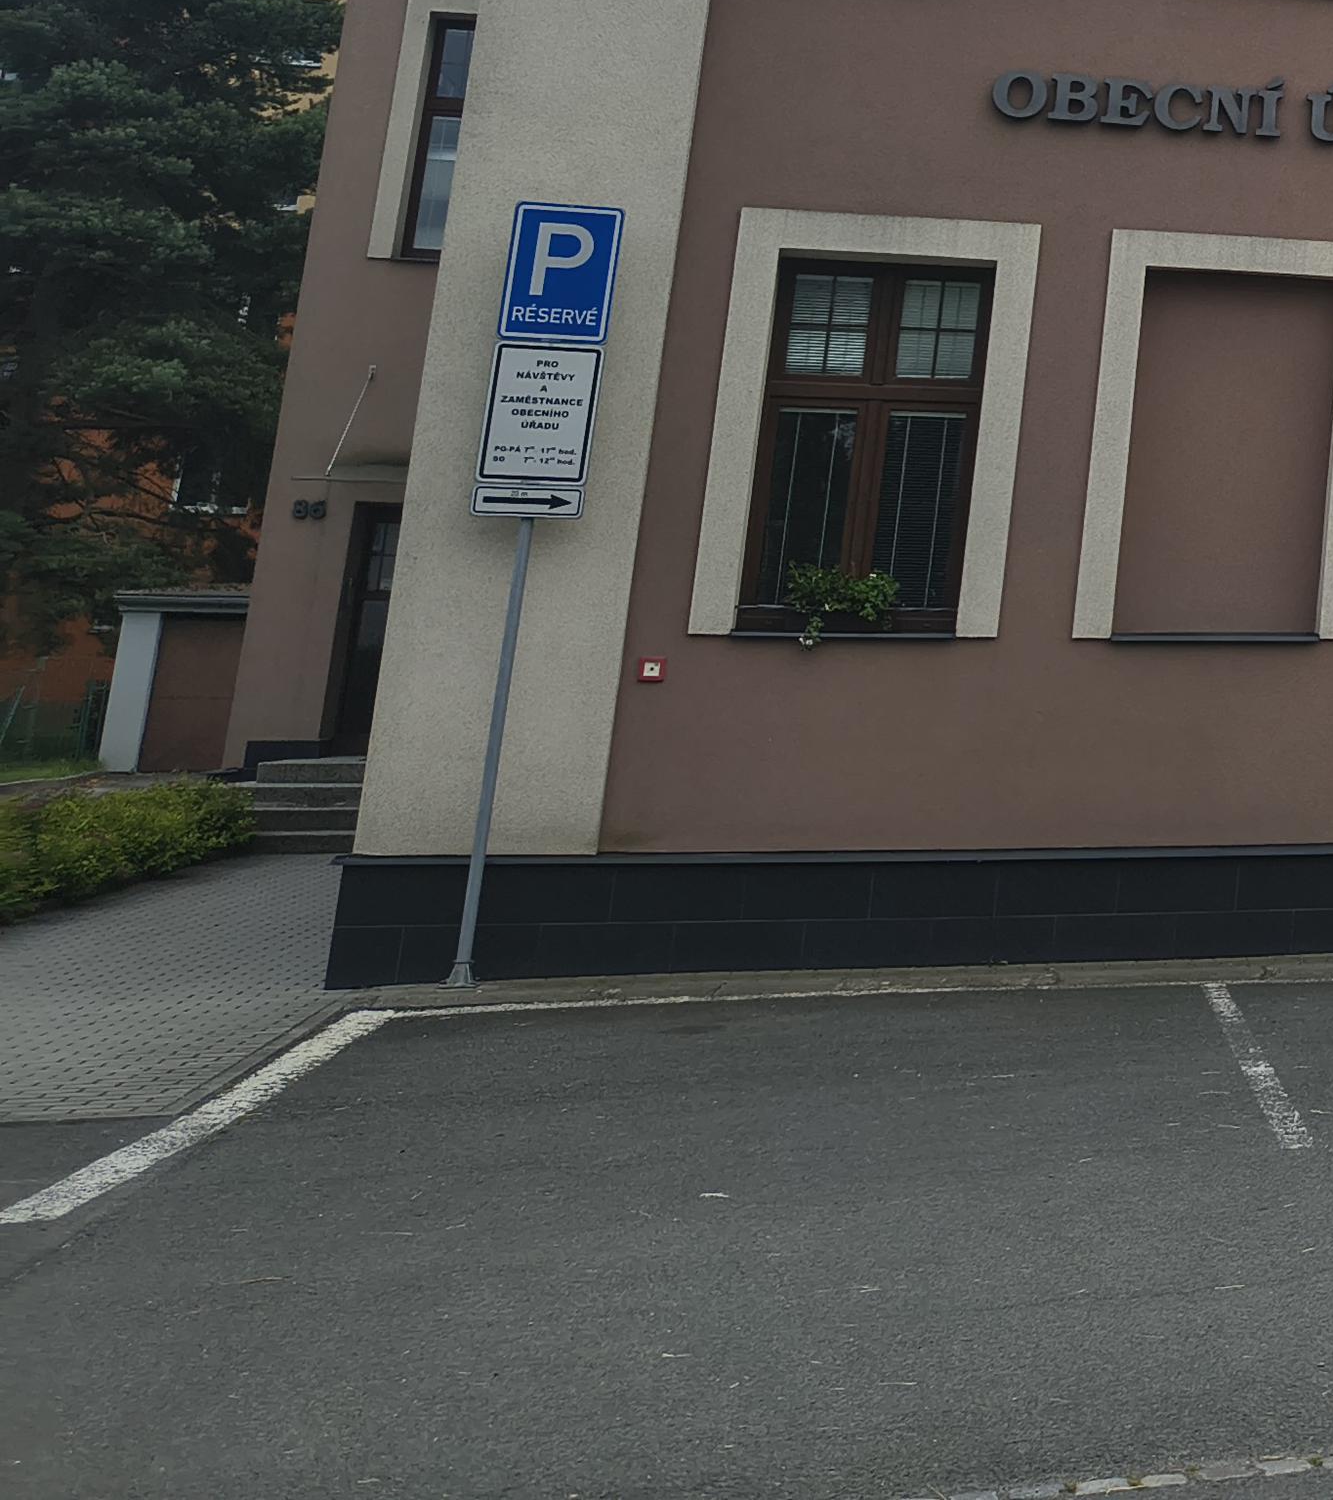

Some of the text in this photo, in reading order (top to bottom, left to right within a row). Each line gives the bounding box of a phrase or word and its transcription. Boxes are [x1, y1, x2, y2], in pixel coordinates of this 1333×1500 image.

[991, 69, 1286, 138] OBECNÍ
[529, 222, 595, 296] P
[511, 304, 598, 326] RÉSERVÉ
[536, 360, 559, 368] PRO
[540, 384, 548, 393] A
[511, 408, 569, 418] OBECNÍHO
[292, 500, 327, 520] 86
